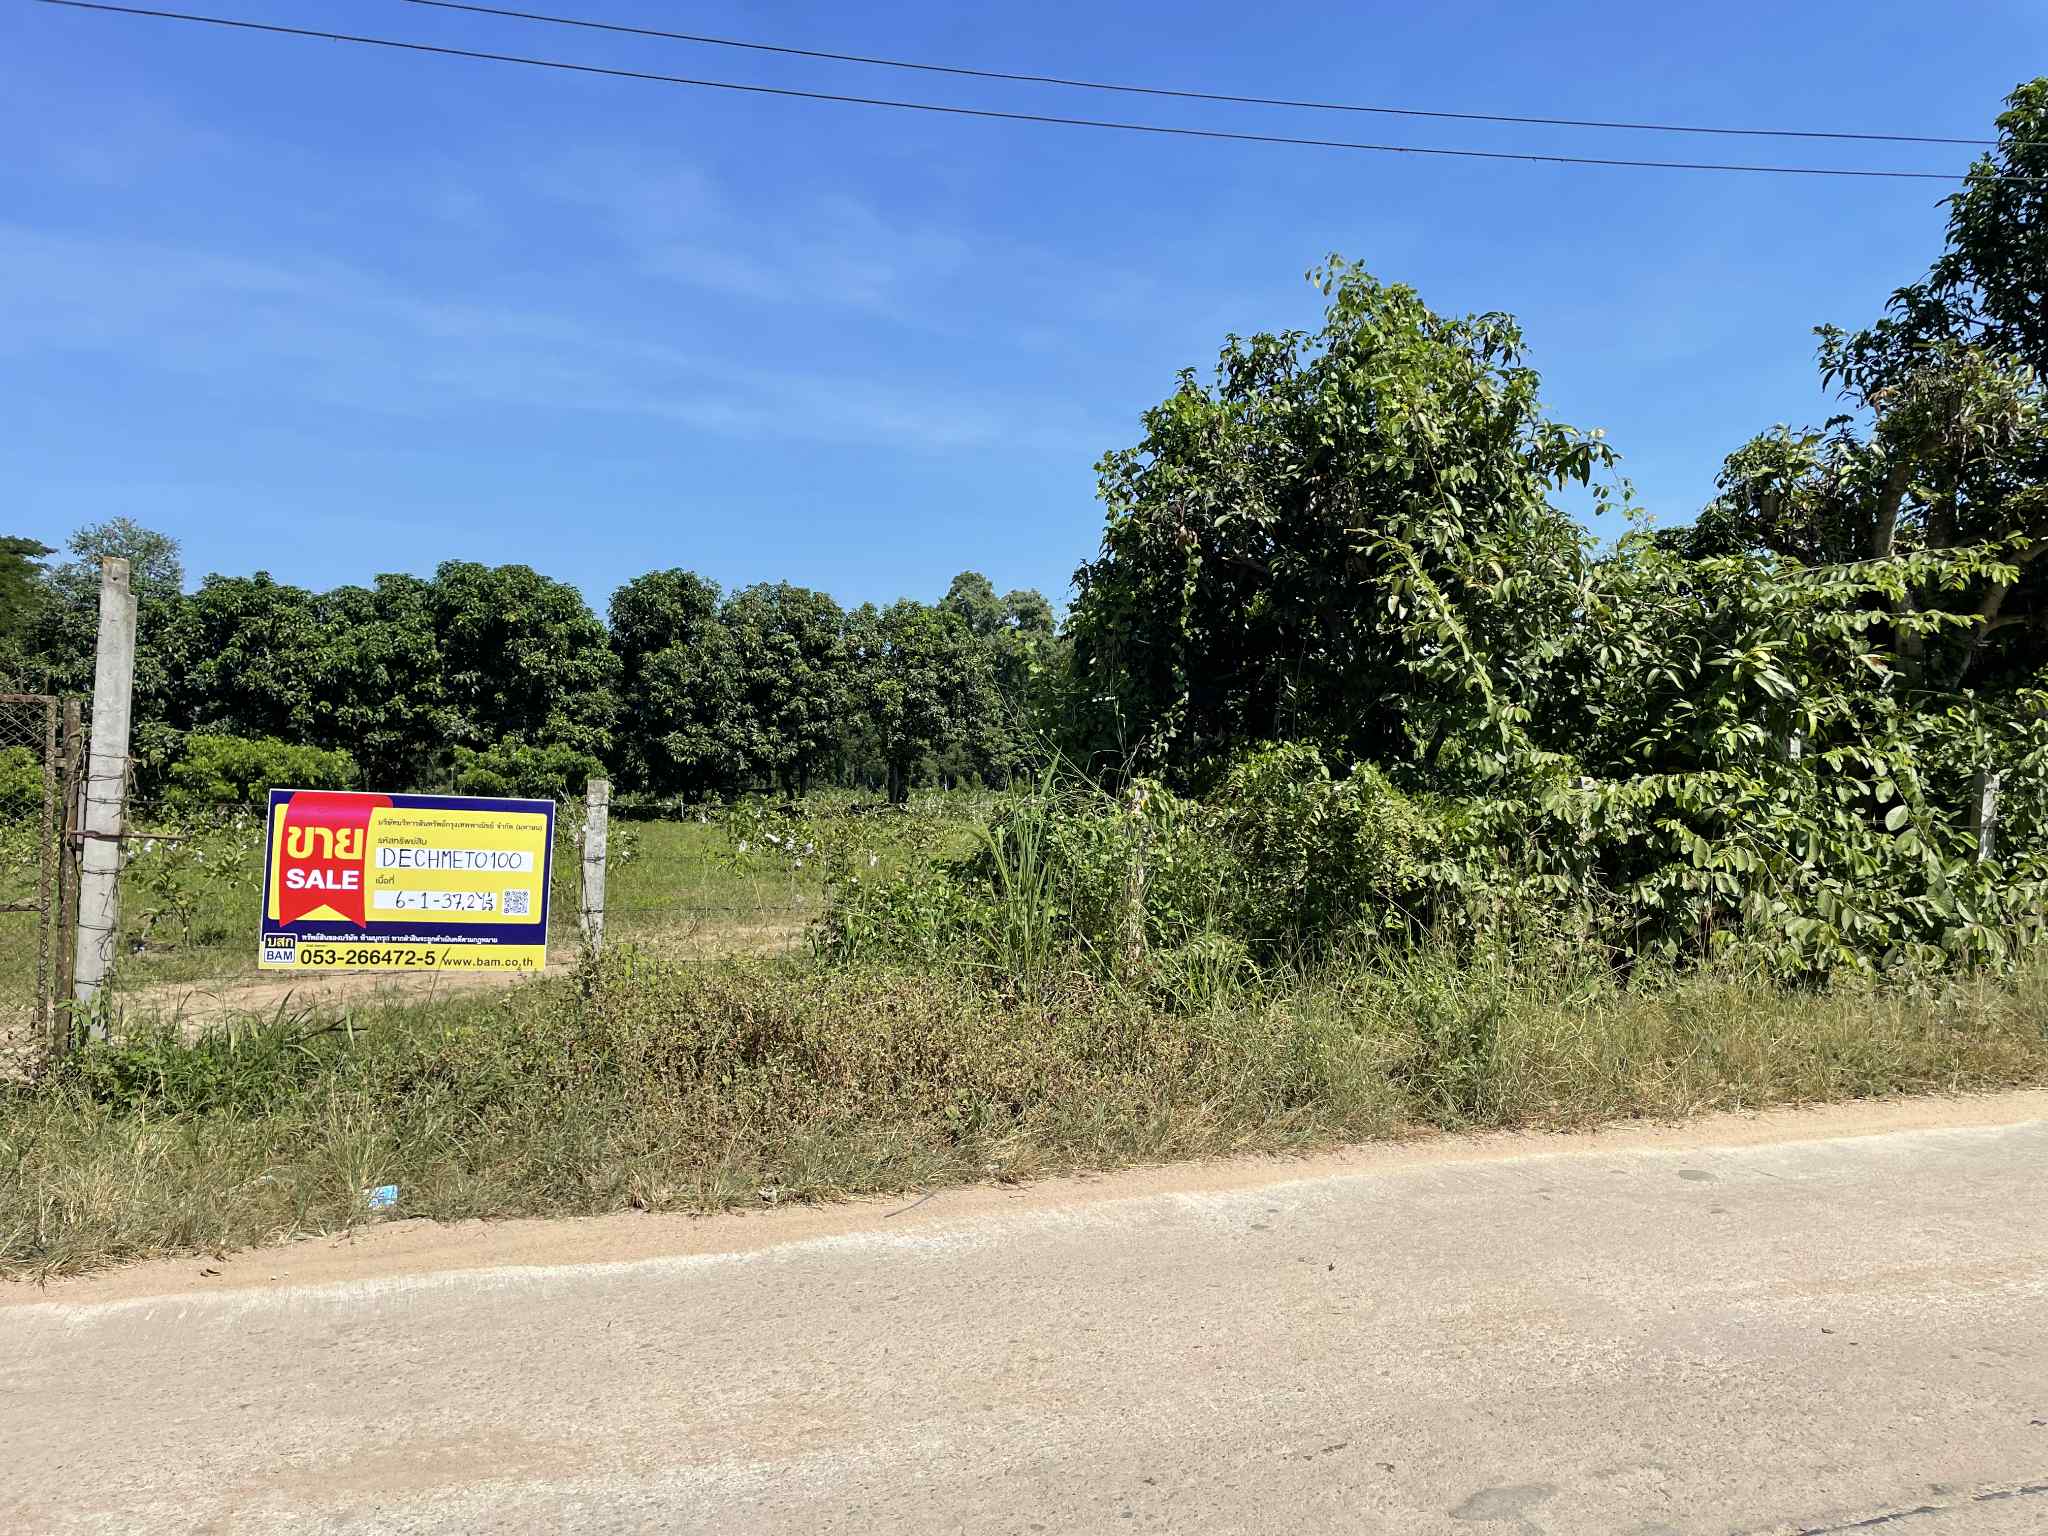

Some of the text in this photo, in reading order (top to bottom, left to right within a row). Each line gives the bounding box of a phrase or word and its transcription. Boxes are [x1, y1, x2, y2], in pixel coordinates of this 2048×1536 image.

[497, 822, 514, 830] จำกัด
[515, 823, 543, 832] (มหาชน)
[287, 826, 364, 859] ขาย
[286, 868, 360, 890] SALE
[267, 936, 294, 948] บสก
[266, 950, 293, 960] BAM
[300, 949, 533, 966] 053-266472-5 www.bam.co.th
